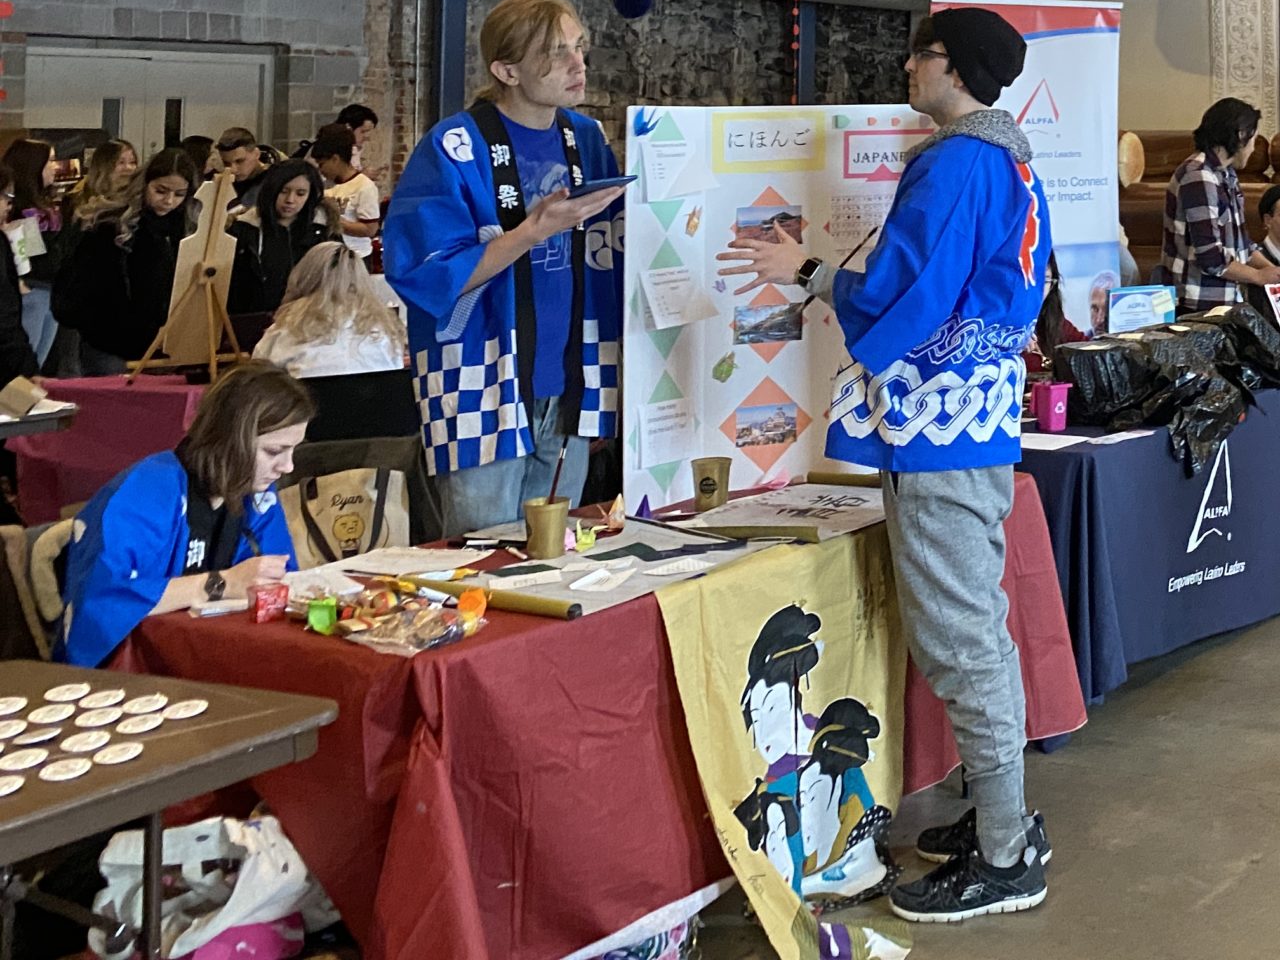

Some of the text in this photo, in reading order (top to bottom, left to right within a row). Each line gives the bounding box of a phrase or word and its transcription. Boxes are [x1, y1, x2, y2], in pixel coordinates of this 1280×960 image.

[728, 128, 810, 149] にほんご
[1047, 176, 1056, 188] is
[1057, 177, 1068, 188] to
[1070, 176, 1108, 187] Connect
[330, 493, 364, 511] Ryan
[1203, 505, 1229, 519] ALPFA
[1203, 565, 1223, 581] Latino
